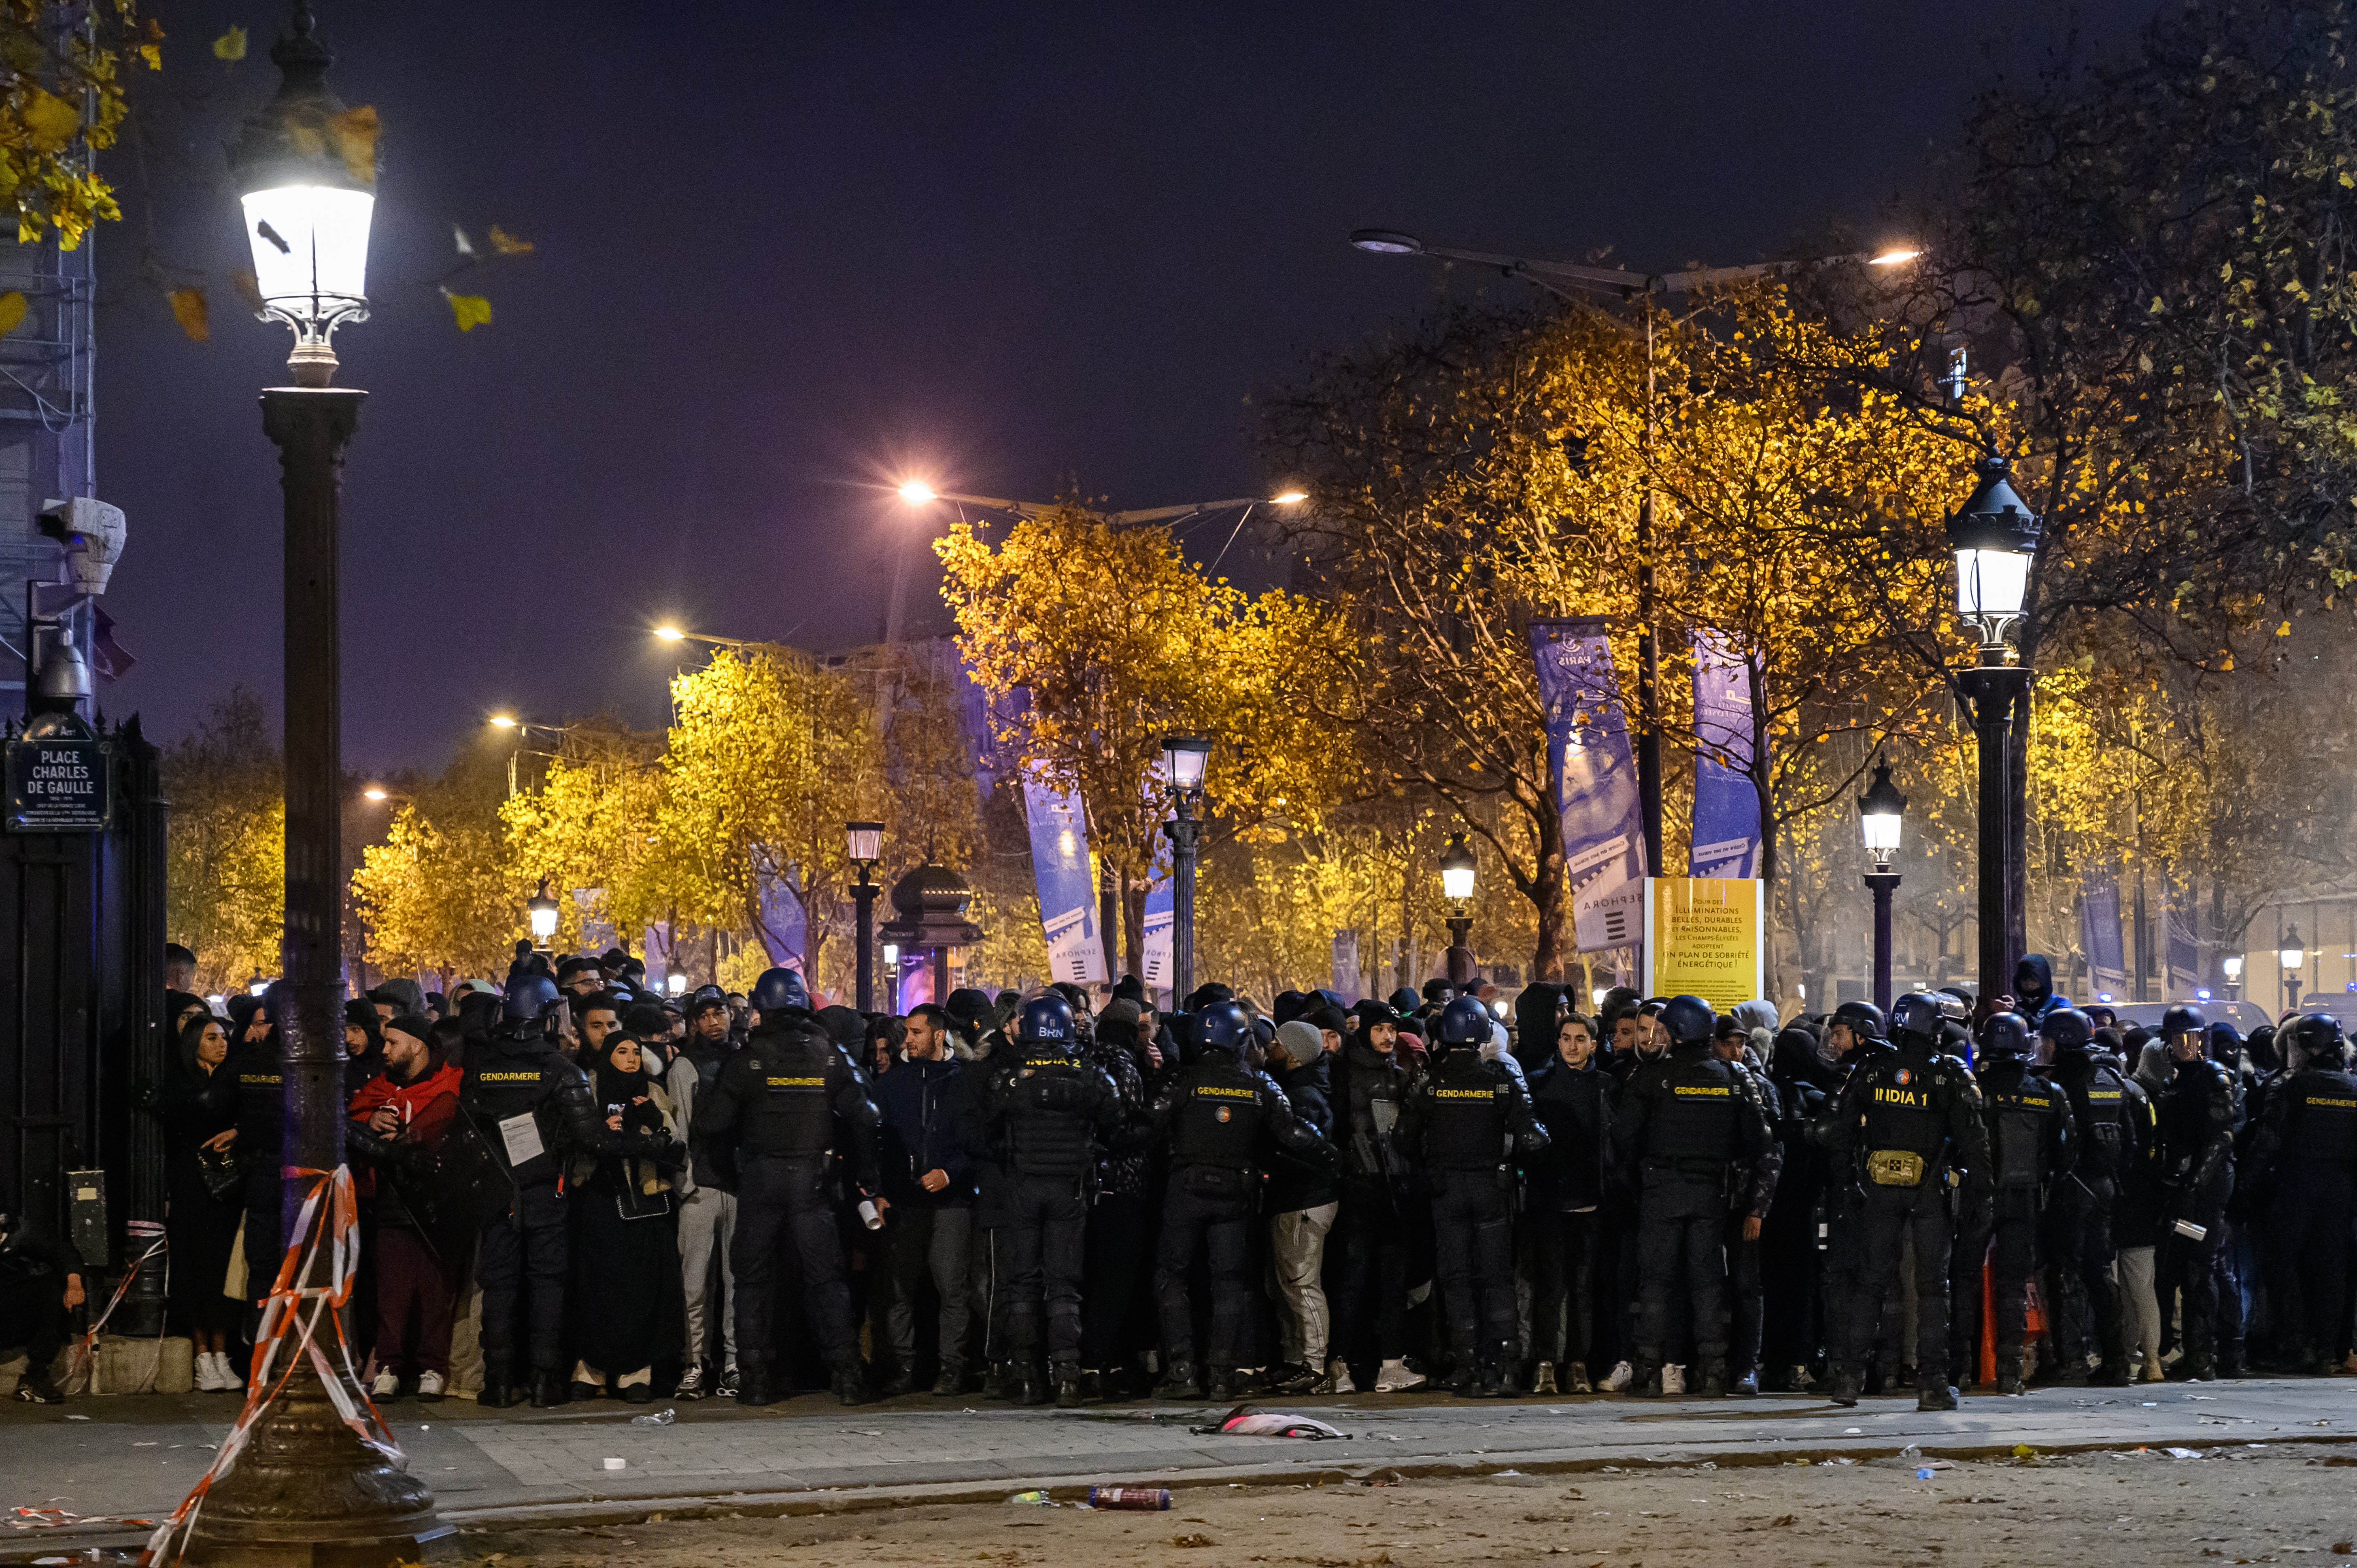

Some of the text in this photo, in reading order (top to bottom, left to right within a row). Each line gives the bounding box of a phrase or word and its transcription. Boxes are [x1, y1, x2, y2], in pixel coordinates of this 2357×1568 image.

[41, 751, 79, 764] PLACE
[33, 766, 88, 779] CHARLES
[28, 781, 94, 794] DE GAULLE
[1676, 906, 1739, 914] ILLUMINATIONS
[1715, 951, 1749, 959] SOBRIÉTÉ
[1678, 960, 1732, 970] ÉNERGÉTIQUE
[1072, 1059, 1081, 1068] 2
[480, 1072, 540, 1081] GENDARMERIE
[1198, 1086, 1253, 1098] GENDARMERIE
[1437, 1090, 1494, 1098] GENDARMERIE
[1875, 1088, 1928, 1106] INDIA 1
